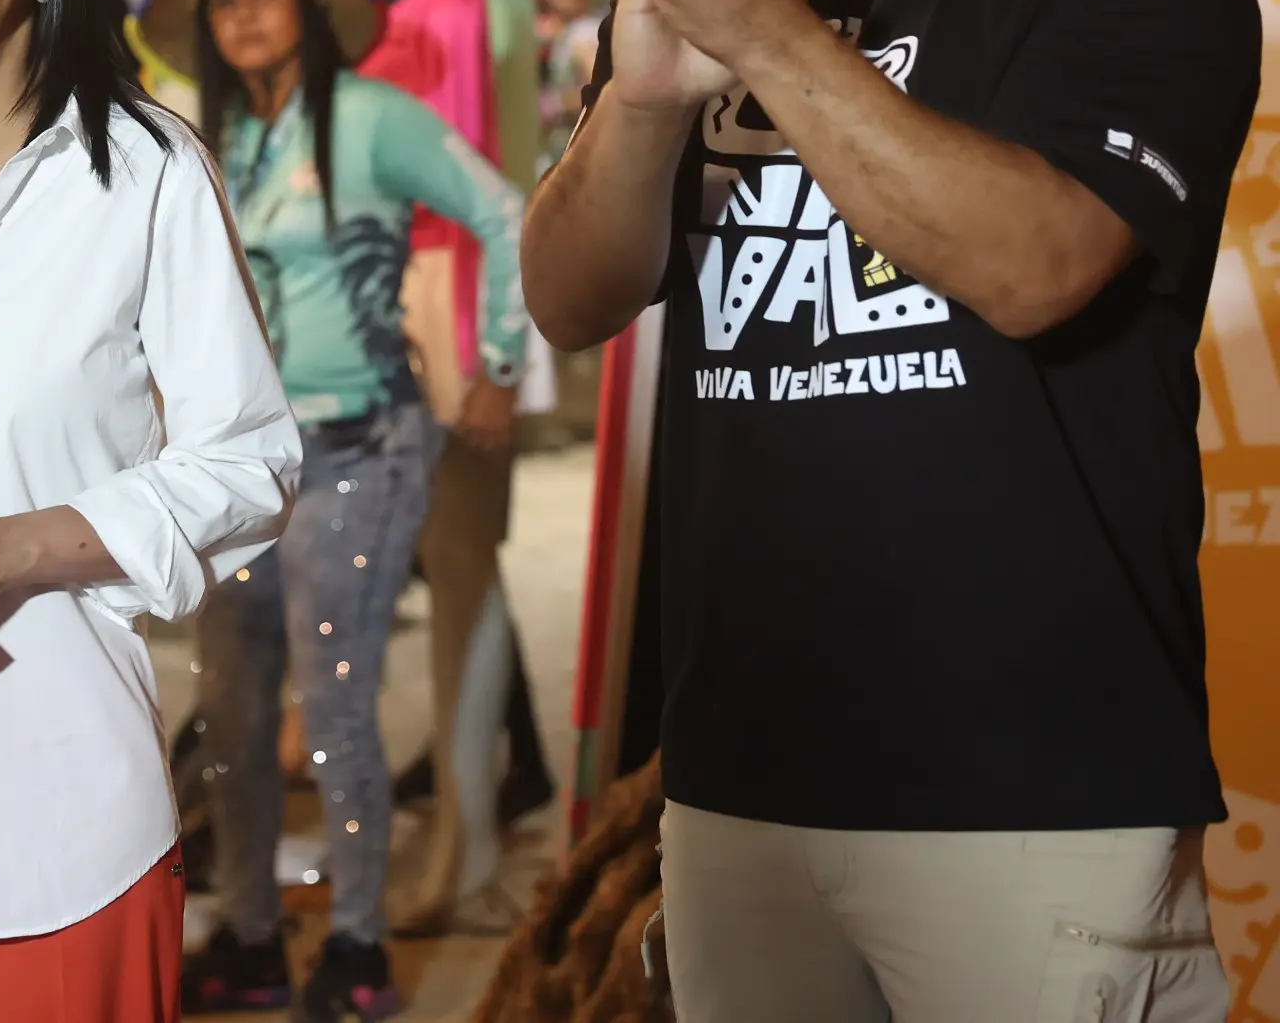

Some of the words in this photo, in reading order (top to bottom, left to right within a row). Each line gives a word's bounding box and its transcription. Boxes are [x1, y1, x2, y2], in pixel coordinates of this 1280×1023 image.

[685, 219, 950, 351] VAL
[695, 366, 755, 401] VIVA
[769, 348, 967, 401] VENEZUELA
